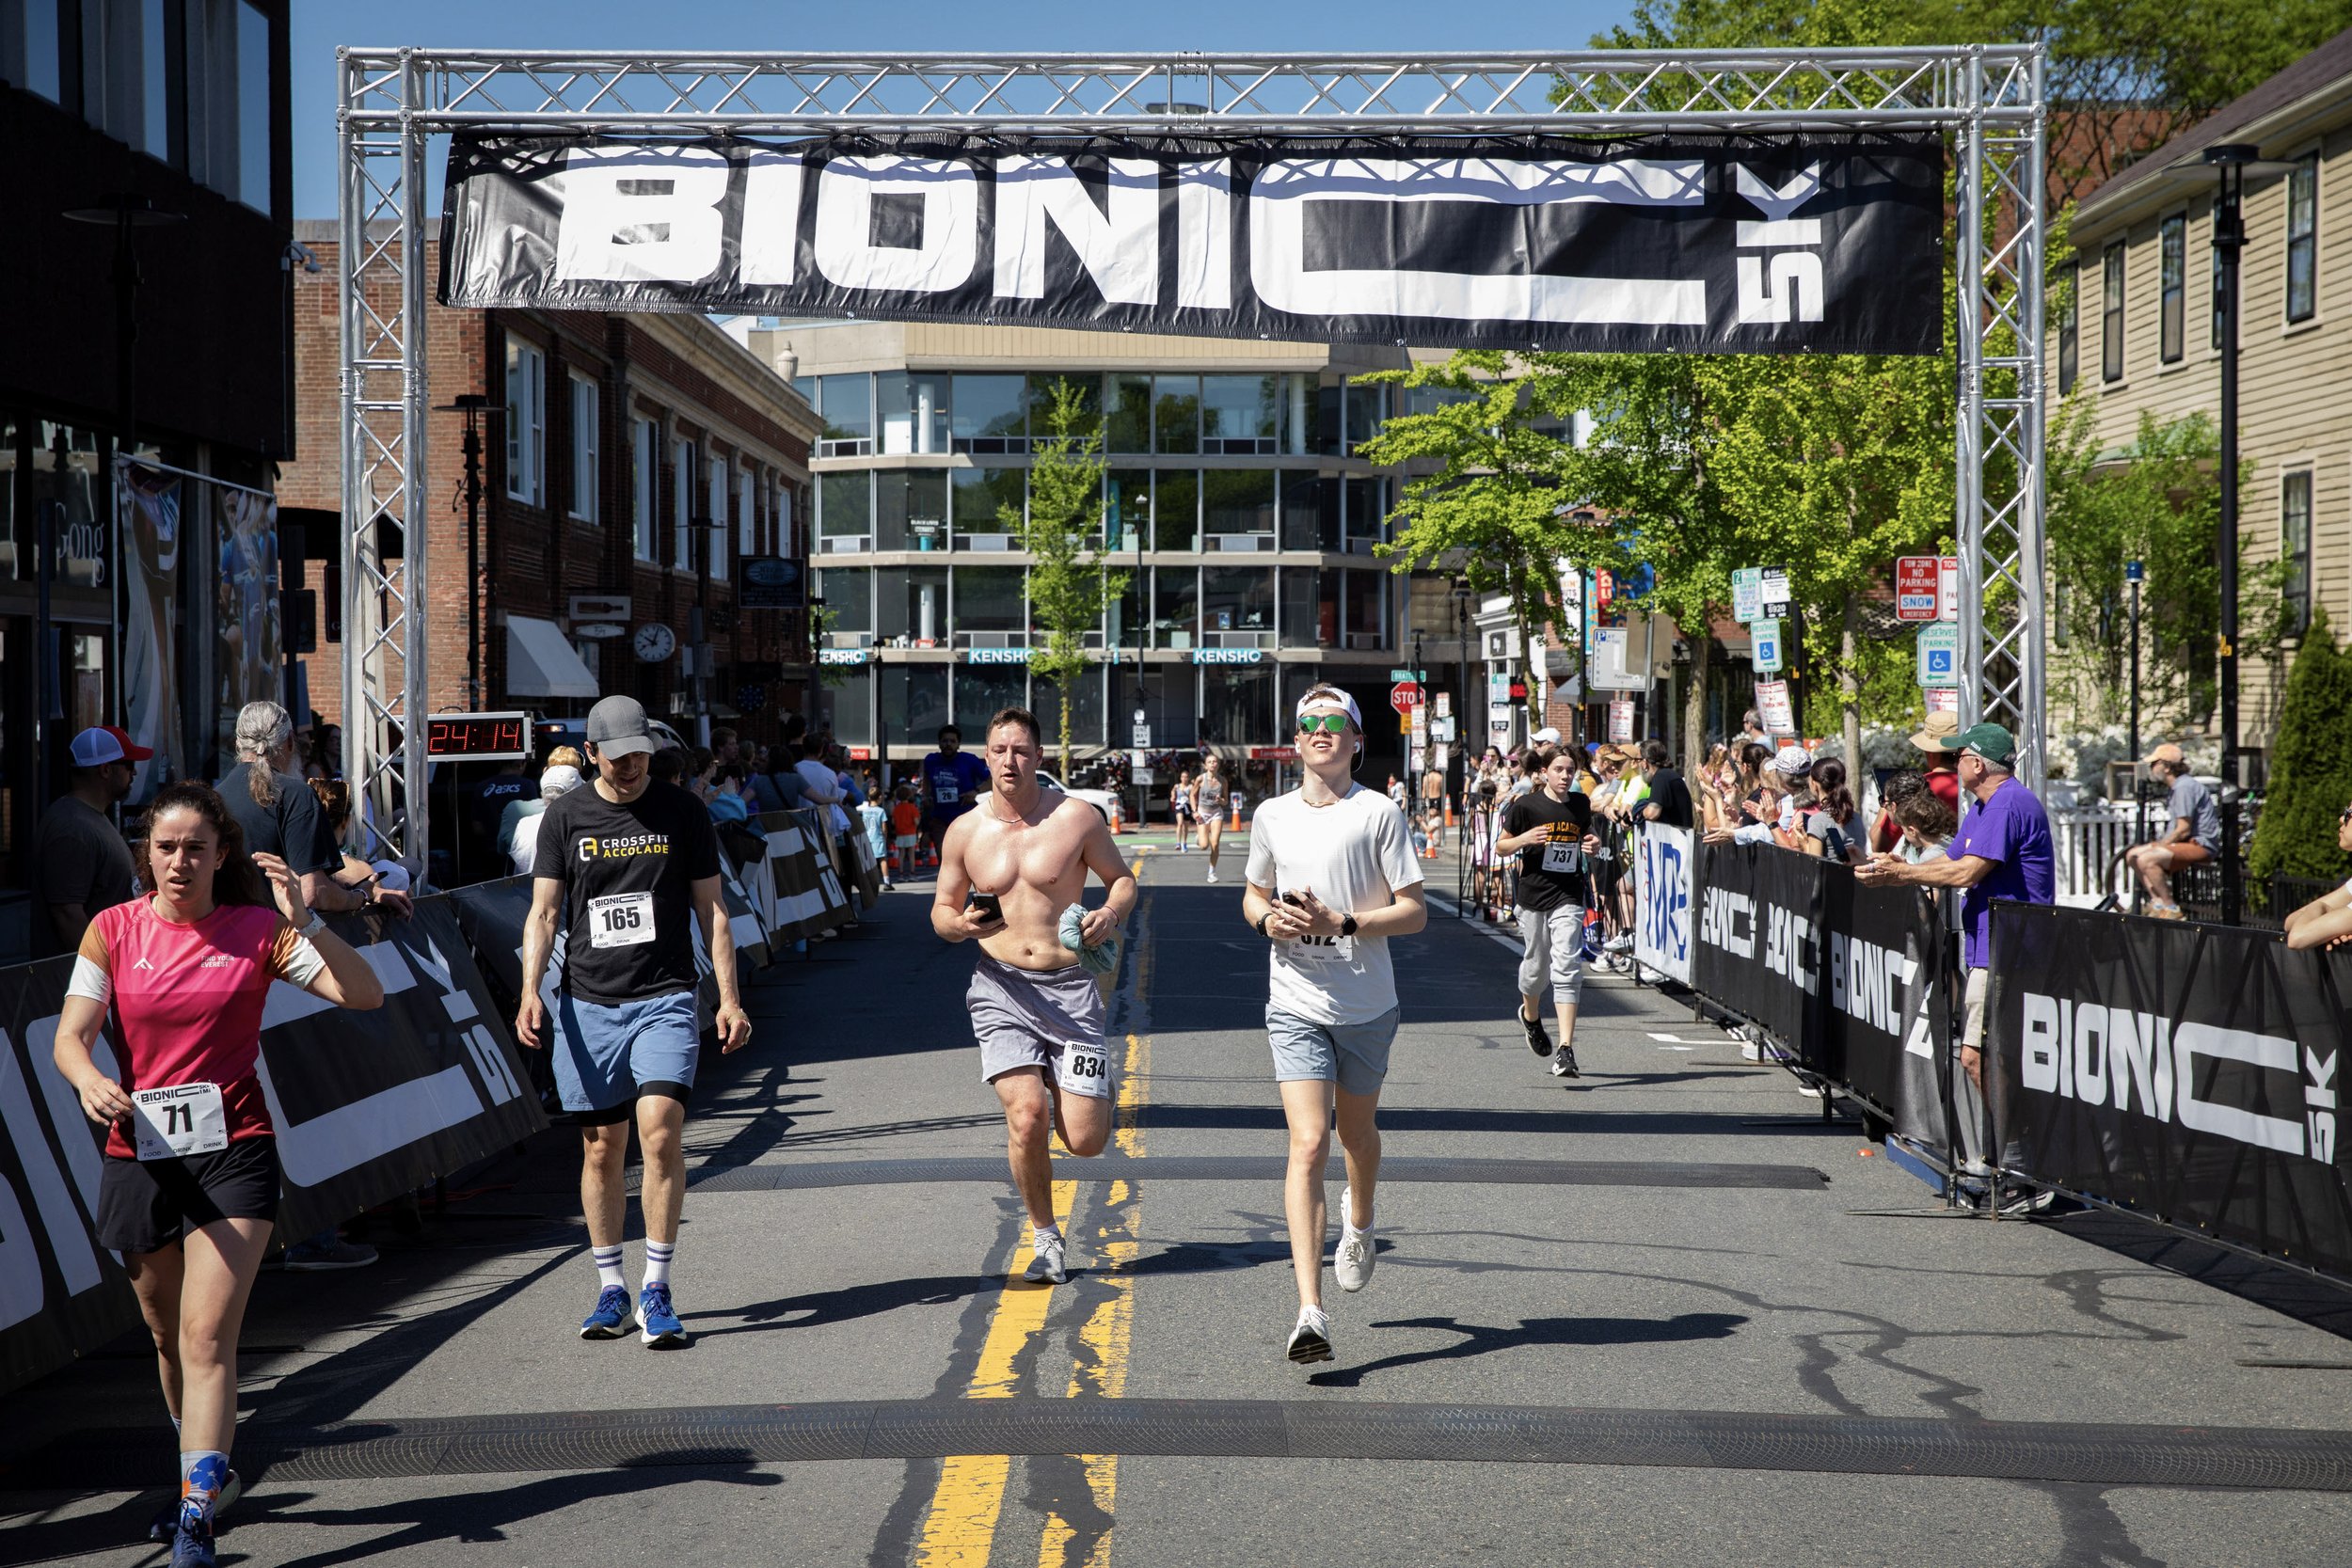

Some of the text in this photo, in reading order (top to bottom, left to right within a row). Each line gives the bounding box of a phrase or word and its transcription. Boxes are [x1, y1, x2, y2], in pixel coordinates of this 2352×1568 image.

[556, 146, 1706, 325] BIONIC
[1735, 159, 1824, 324] 5K
[1734, 572, 1741, 584] 2
[1912, 568, 1925, 578] NO
[1900, 578, 1936, 588] PARKING
[1902, 596, 1933, 608] SNOW
[1924, 640, 1956, 648] PARKING
[1195, 650, 1262, 662] KENSHO
[602, 834, 669, 848] CROSSFIT
[603, 844, 669, 858] ACCOLADE
[1553, 850, 1573, 863] 737
[595, 895, 636, 908] BIONIC
[601, 907, 640, 932] 165
[1832, 931, 1918, 1037] BIONIC
[404, 934, 521, 1107] 5K
[1072, 1043, 1107, 1055] BIONIC
[1073, 1054, 1105, 1080] 834
[2023, 992, 2304, 1156] BIONIC
[140, 1085, 199, 1103] BIONIC
[2305, 1046, 2337, 1165] 5K
[162, 1102, 193, 1135] 71
[172, 1146, 193, 1155] DRINK
[203, 1140, 223, 1149] DRINK
